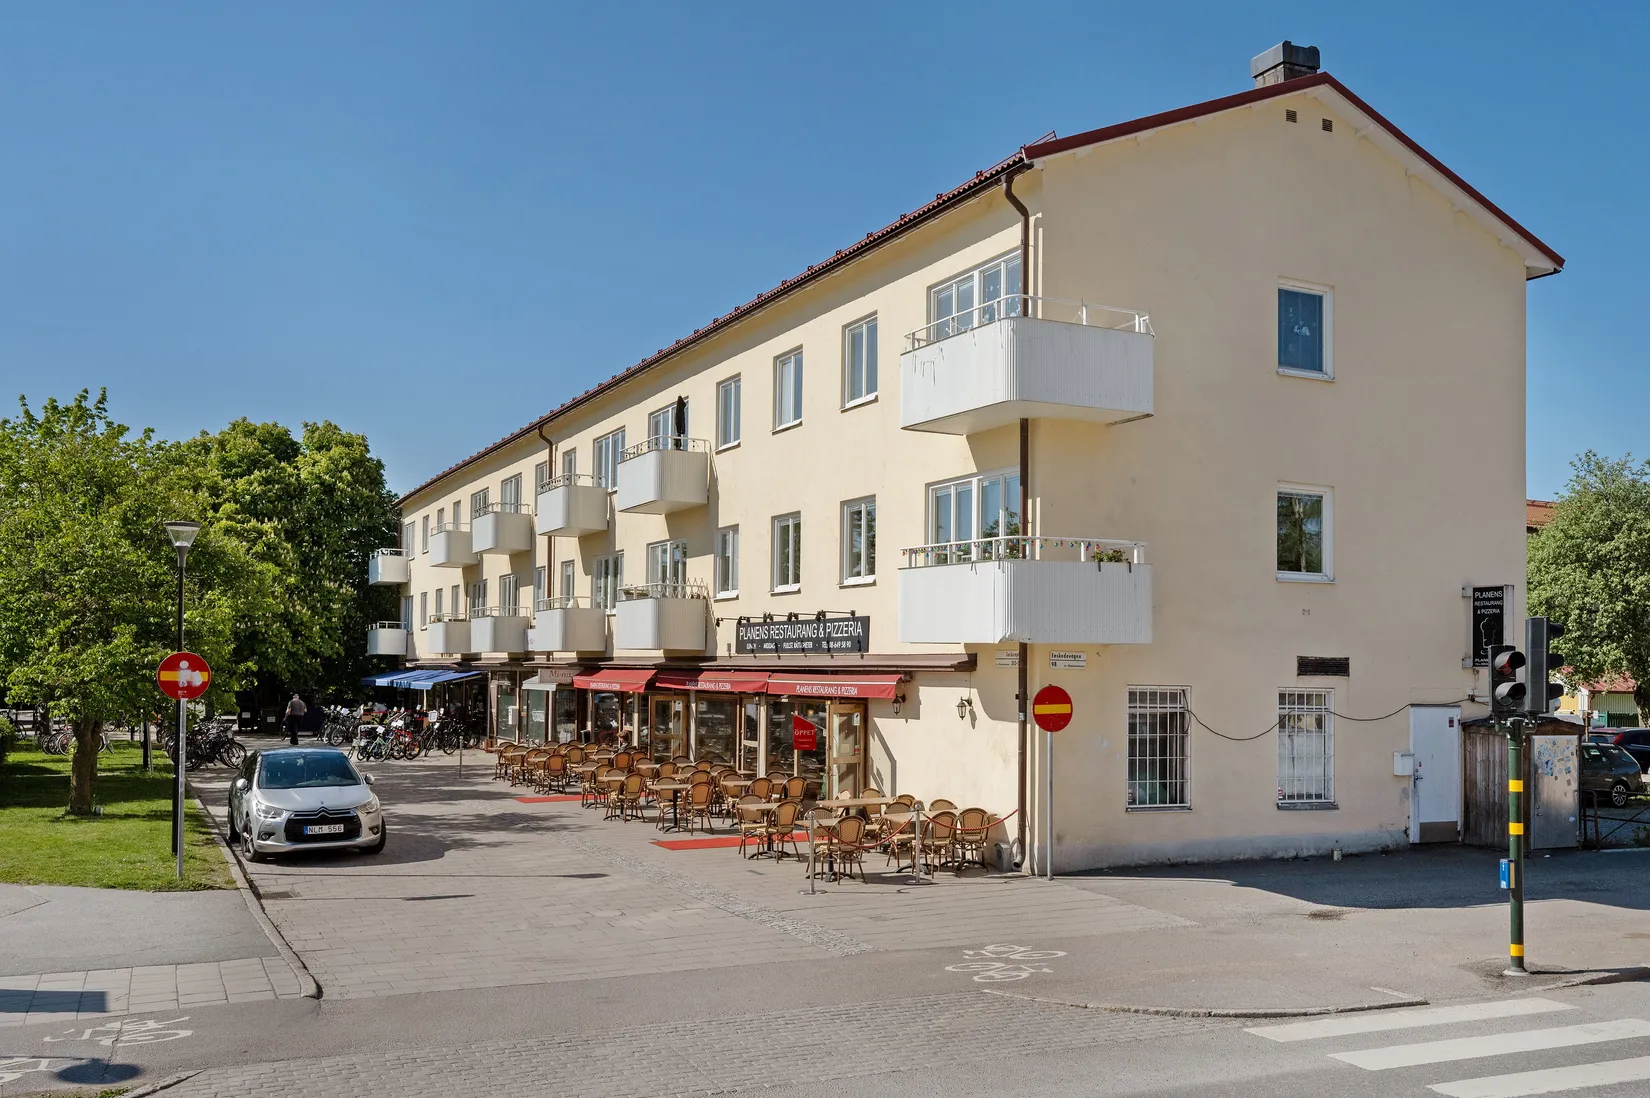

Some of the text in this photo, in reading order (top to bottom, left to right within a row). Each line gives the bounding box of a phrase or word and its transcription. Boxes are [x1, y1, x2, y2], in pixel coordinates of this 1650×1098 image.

[1475, 590, 1502, 598] PLANENS
[739, 621, 863, 640] PLANENS RESTAURANG & PIZZERIA
[796, 685, 812, 693] PLANENS
[813, 685, 837, 694] RESTAURANG
[841, 686, 857, 695] PIZZERIA
